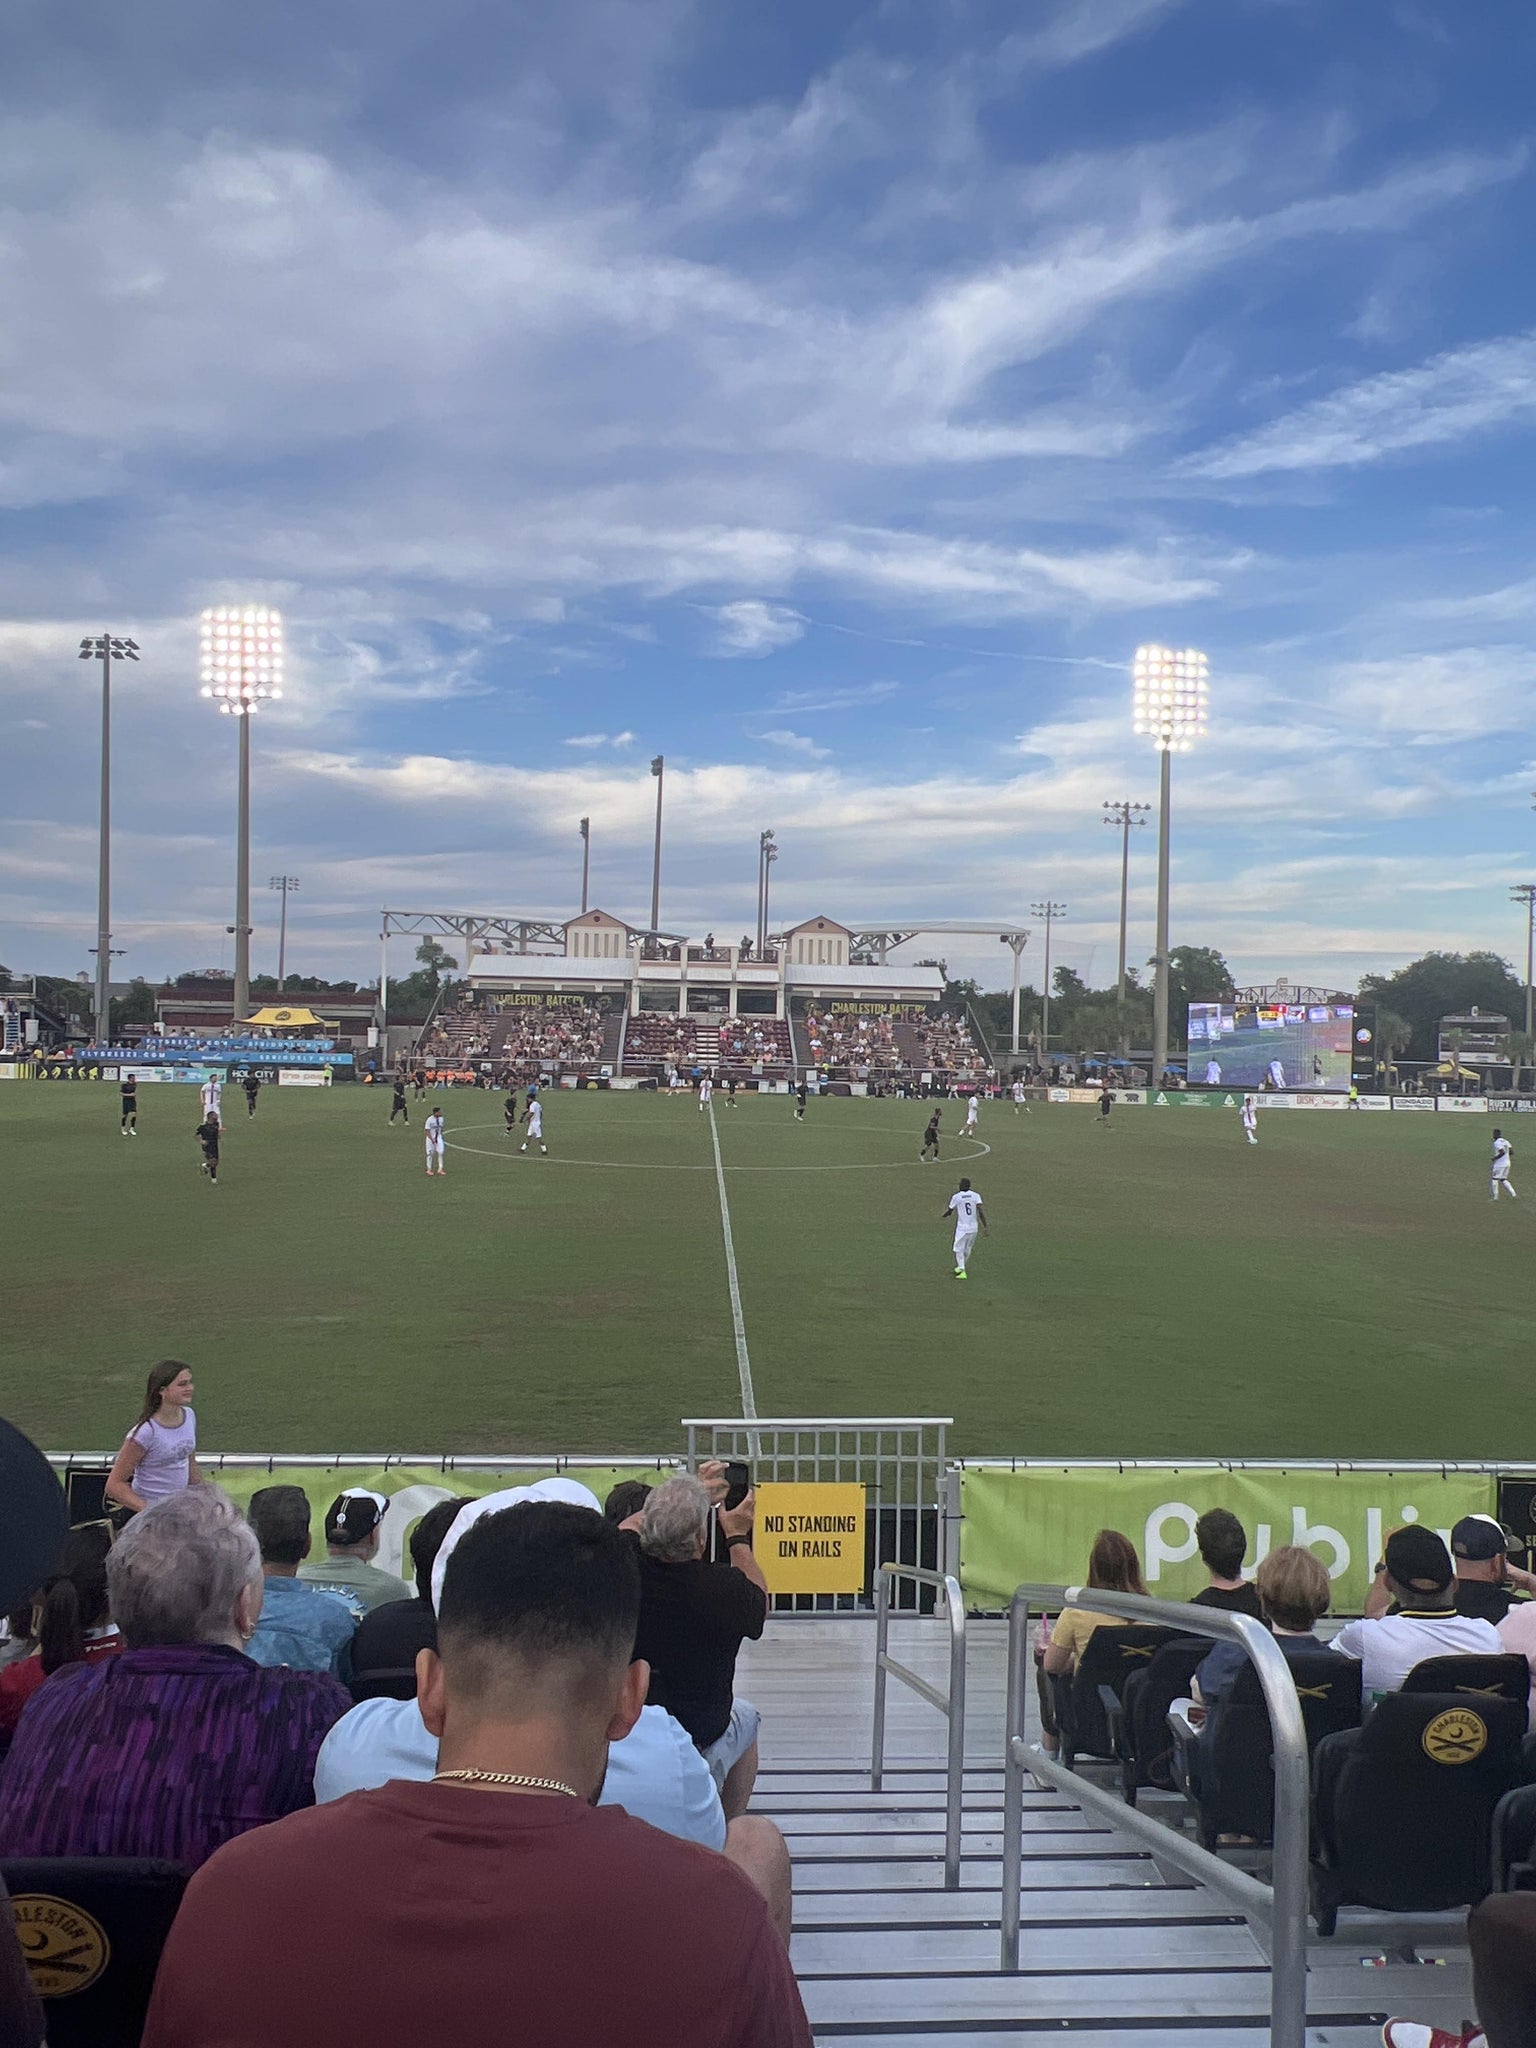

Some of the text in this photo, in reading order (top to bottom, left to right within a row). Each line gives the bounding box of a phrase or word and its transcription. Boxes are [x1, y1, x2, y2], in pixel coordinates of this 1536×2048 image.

[492, 993, 542, 1006] HARLESTON
[831, 1002, 887, 1014] CHARLESTON
[232, 1069, 275, 1079] HOL CITY
[965, 1202, 973, 1216] 6
[764, 1515, 857, 1533] NO STANDING
[778, 1540, 842, 1558] ON RAILS
[1144, 1501, 1458, 1584] Publ
[1432, 1714, 1480, 1735] CHARLESTON
